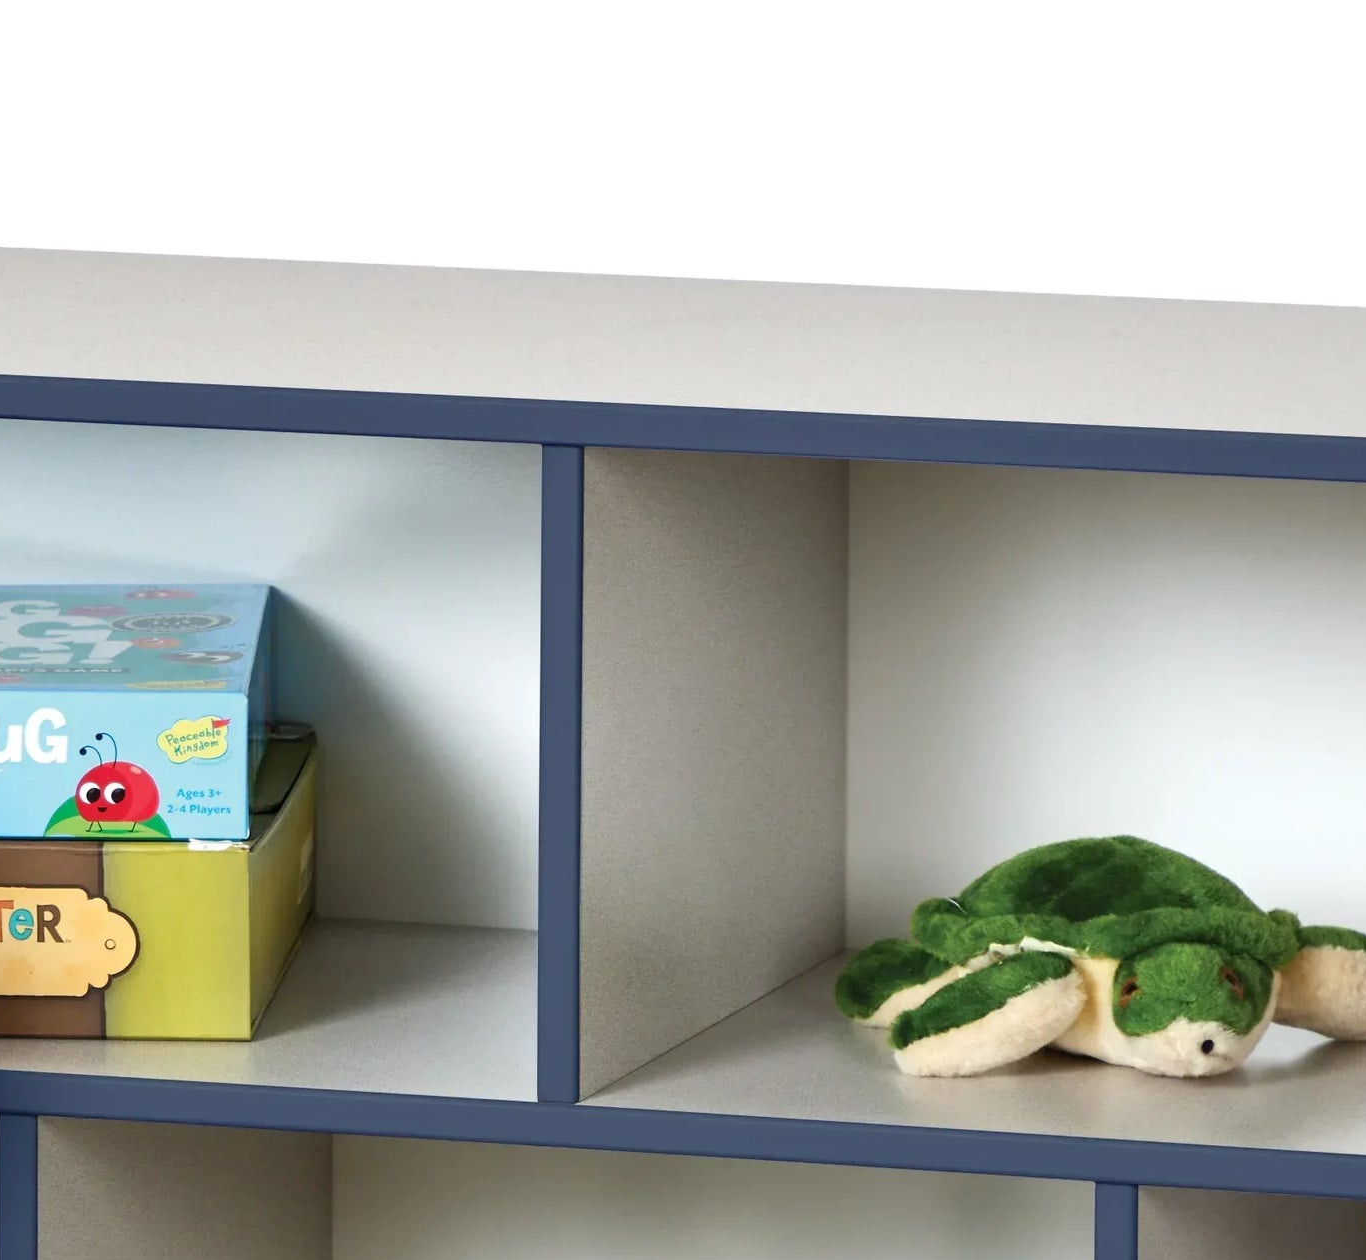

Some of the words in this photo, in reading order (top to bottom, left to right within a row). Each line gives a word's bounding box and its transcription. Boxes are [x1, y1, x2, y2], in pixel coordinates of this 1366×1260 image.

[165, 722, 222, 746] Peaceable
[173, 739, 219, 757] Kingdom
[176, 788, 205, 801] Ages
[208, 788, 222, 798] 3+
[167, 804, 187, 814] 2-4
[190, 804, 232, 816] Players
